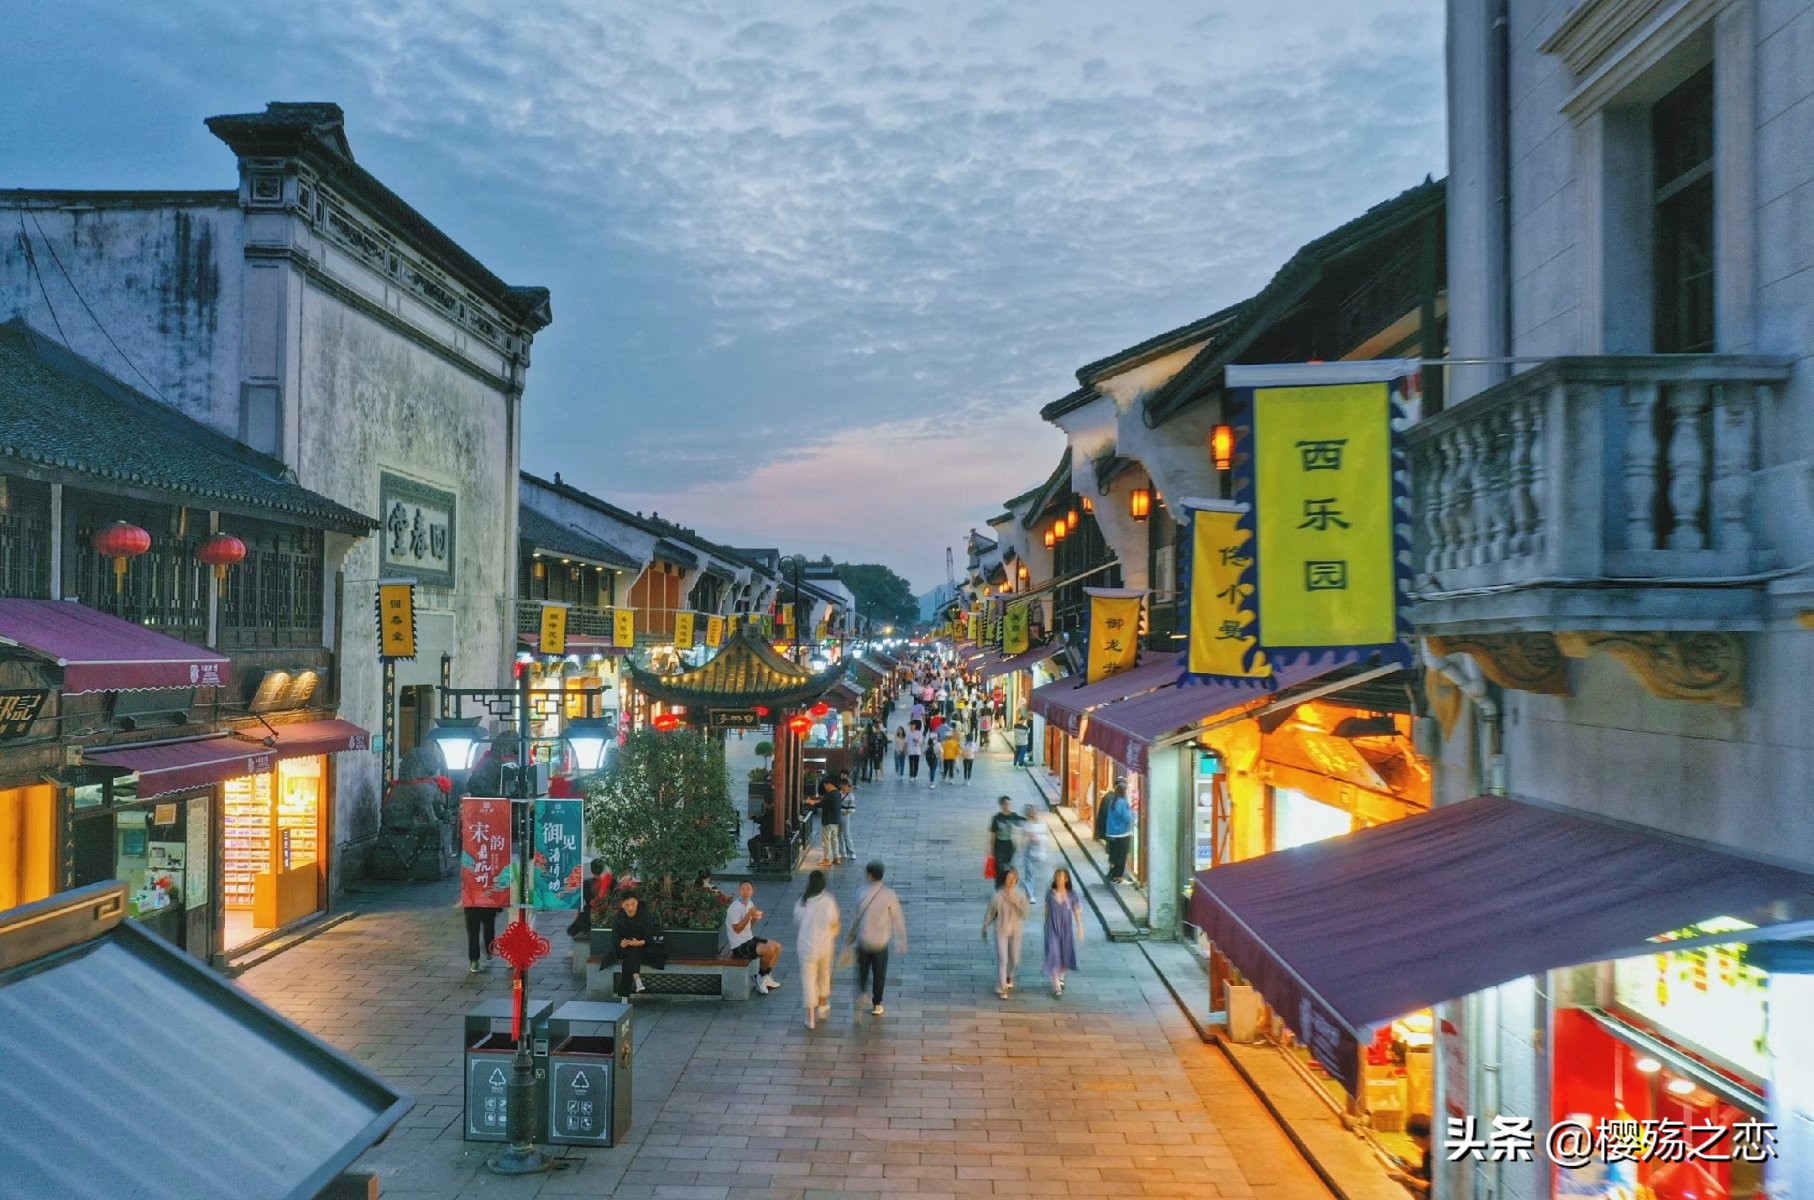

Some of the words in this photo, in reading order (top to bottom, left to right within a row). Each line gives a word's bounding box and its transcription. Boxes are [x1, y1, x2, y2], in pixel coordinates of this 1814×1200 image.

[1294, 438, 1352, 593] 西乐园
[390, 599, 403, 642] 回春堂
[469, 822, 505, 851] 宋韵
[543, 822, 577, 851] 御见
[548, 847, 561, 892] 清河坊
